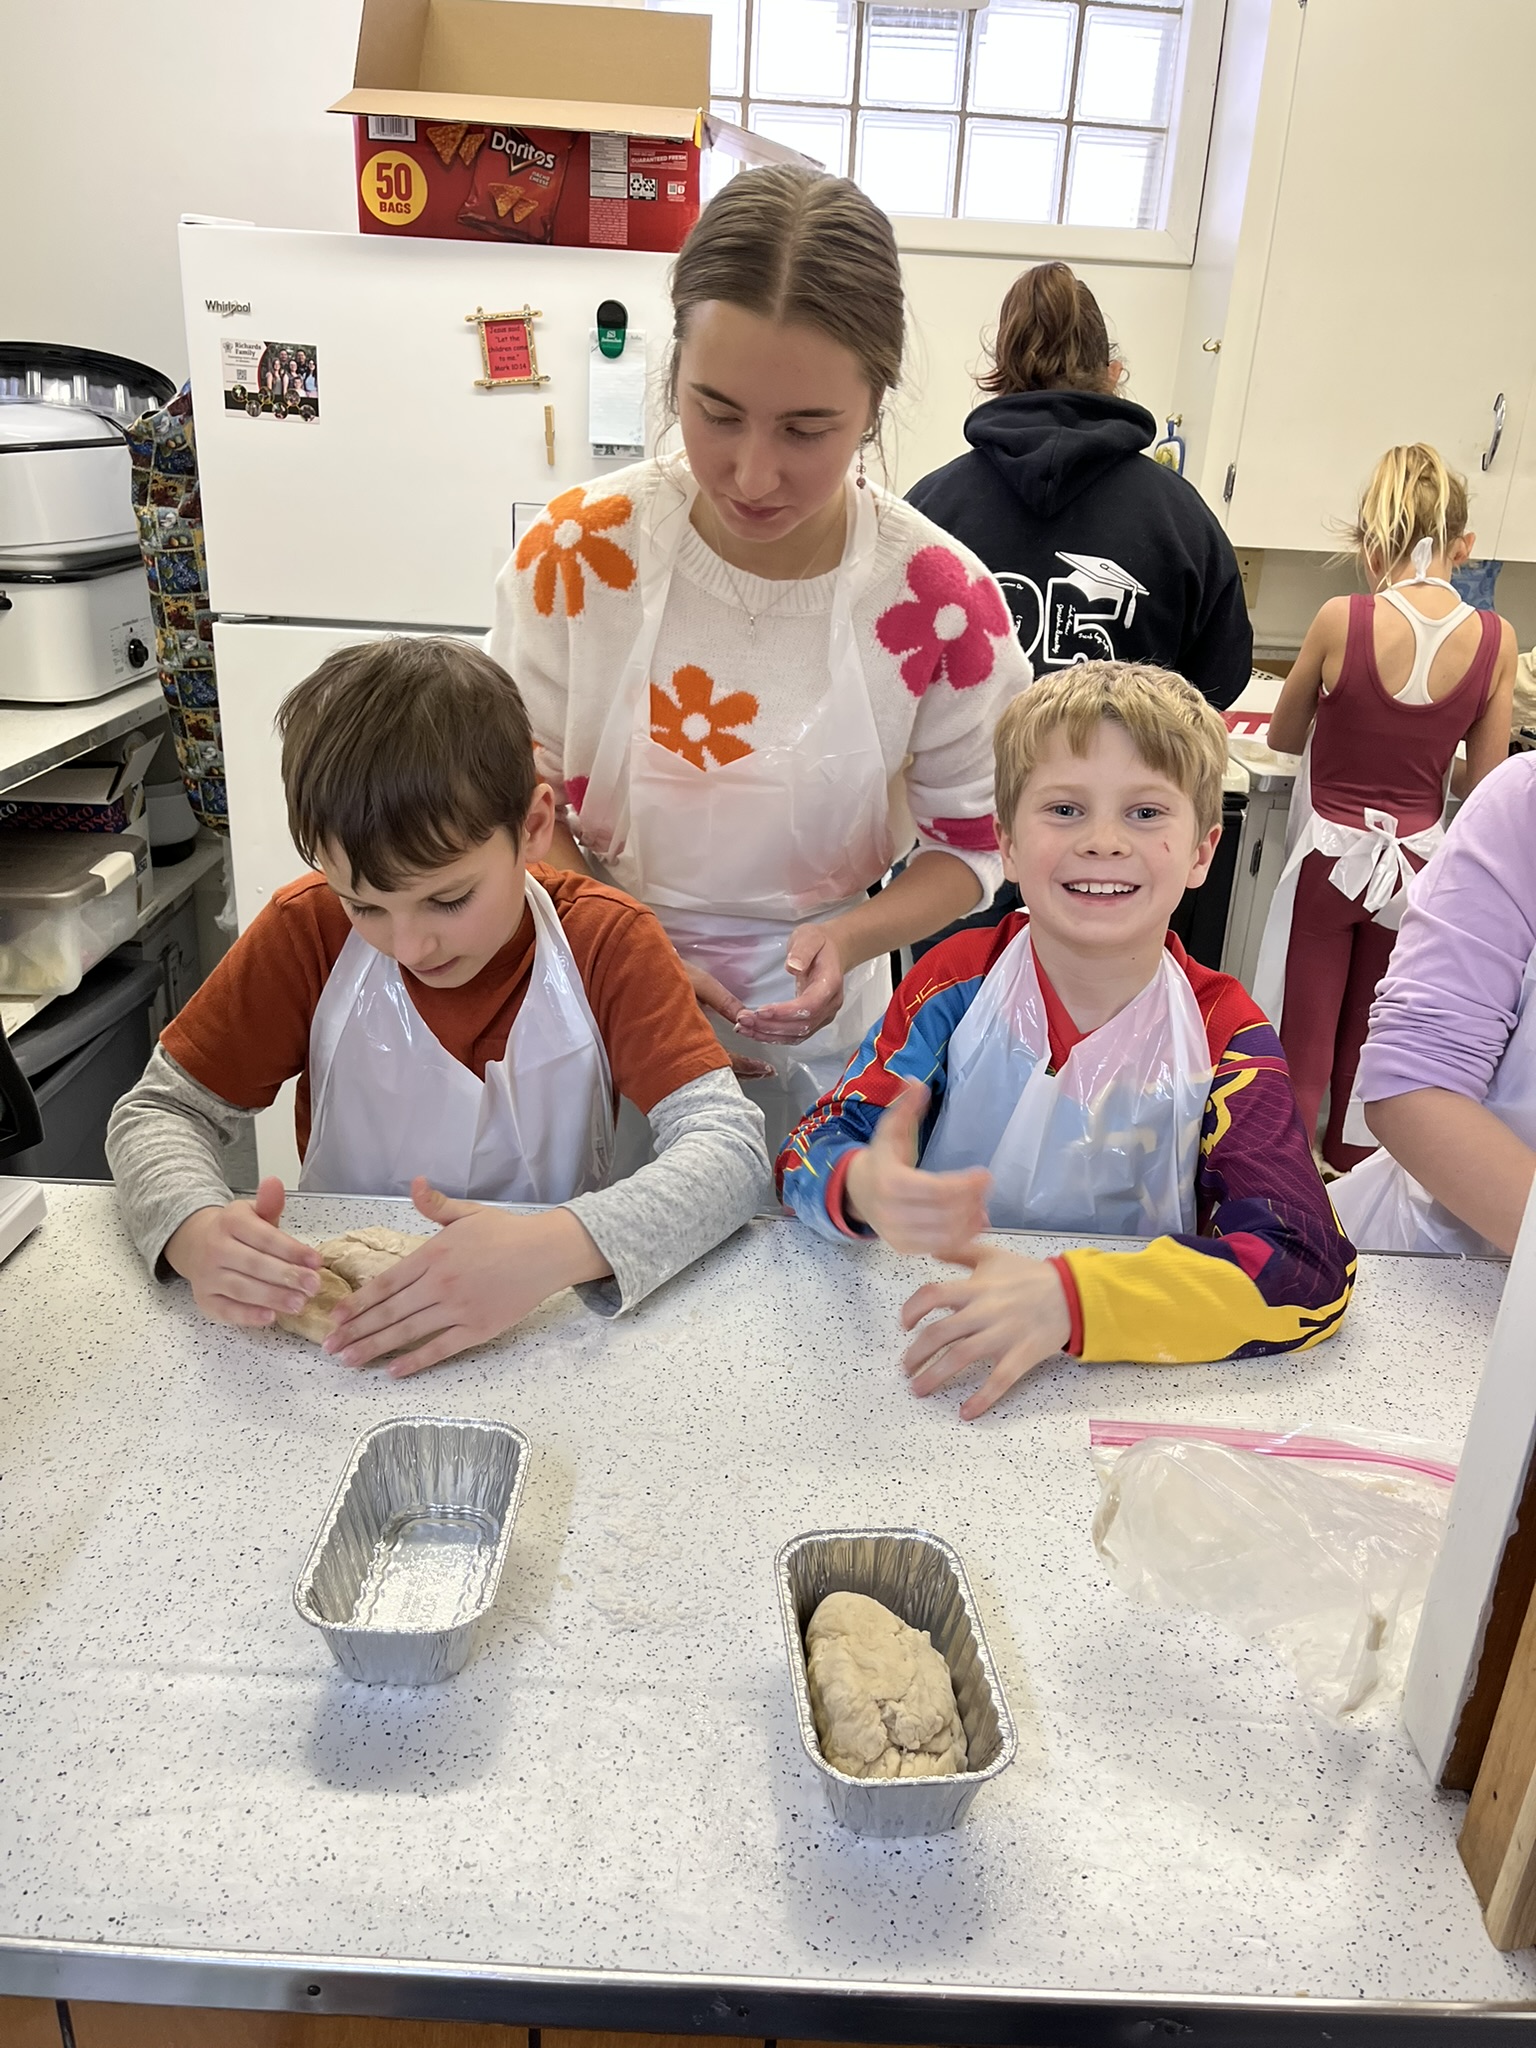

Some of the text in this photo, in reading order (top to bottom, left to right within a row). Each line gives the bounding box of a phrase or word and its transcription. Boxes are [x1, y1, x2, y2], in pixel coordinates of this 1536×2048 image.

[491, 130, 556, 169] Doritos
[631, 155, 668, 163] GUARANTEED
[376, 162, 413, 202] 50
[529, 175, 550, 186] CHEESE
[379, 201, 412, 214] BAGS
[205, 299, 251, 316] Whirlpool
[490, 326, 507, 334] Jesus
[235, 342, 261, 350] Richards
[235, 349, 256, 357] Family
[54, 806, 94, 830] SYSCO
